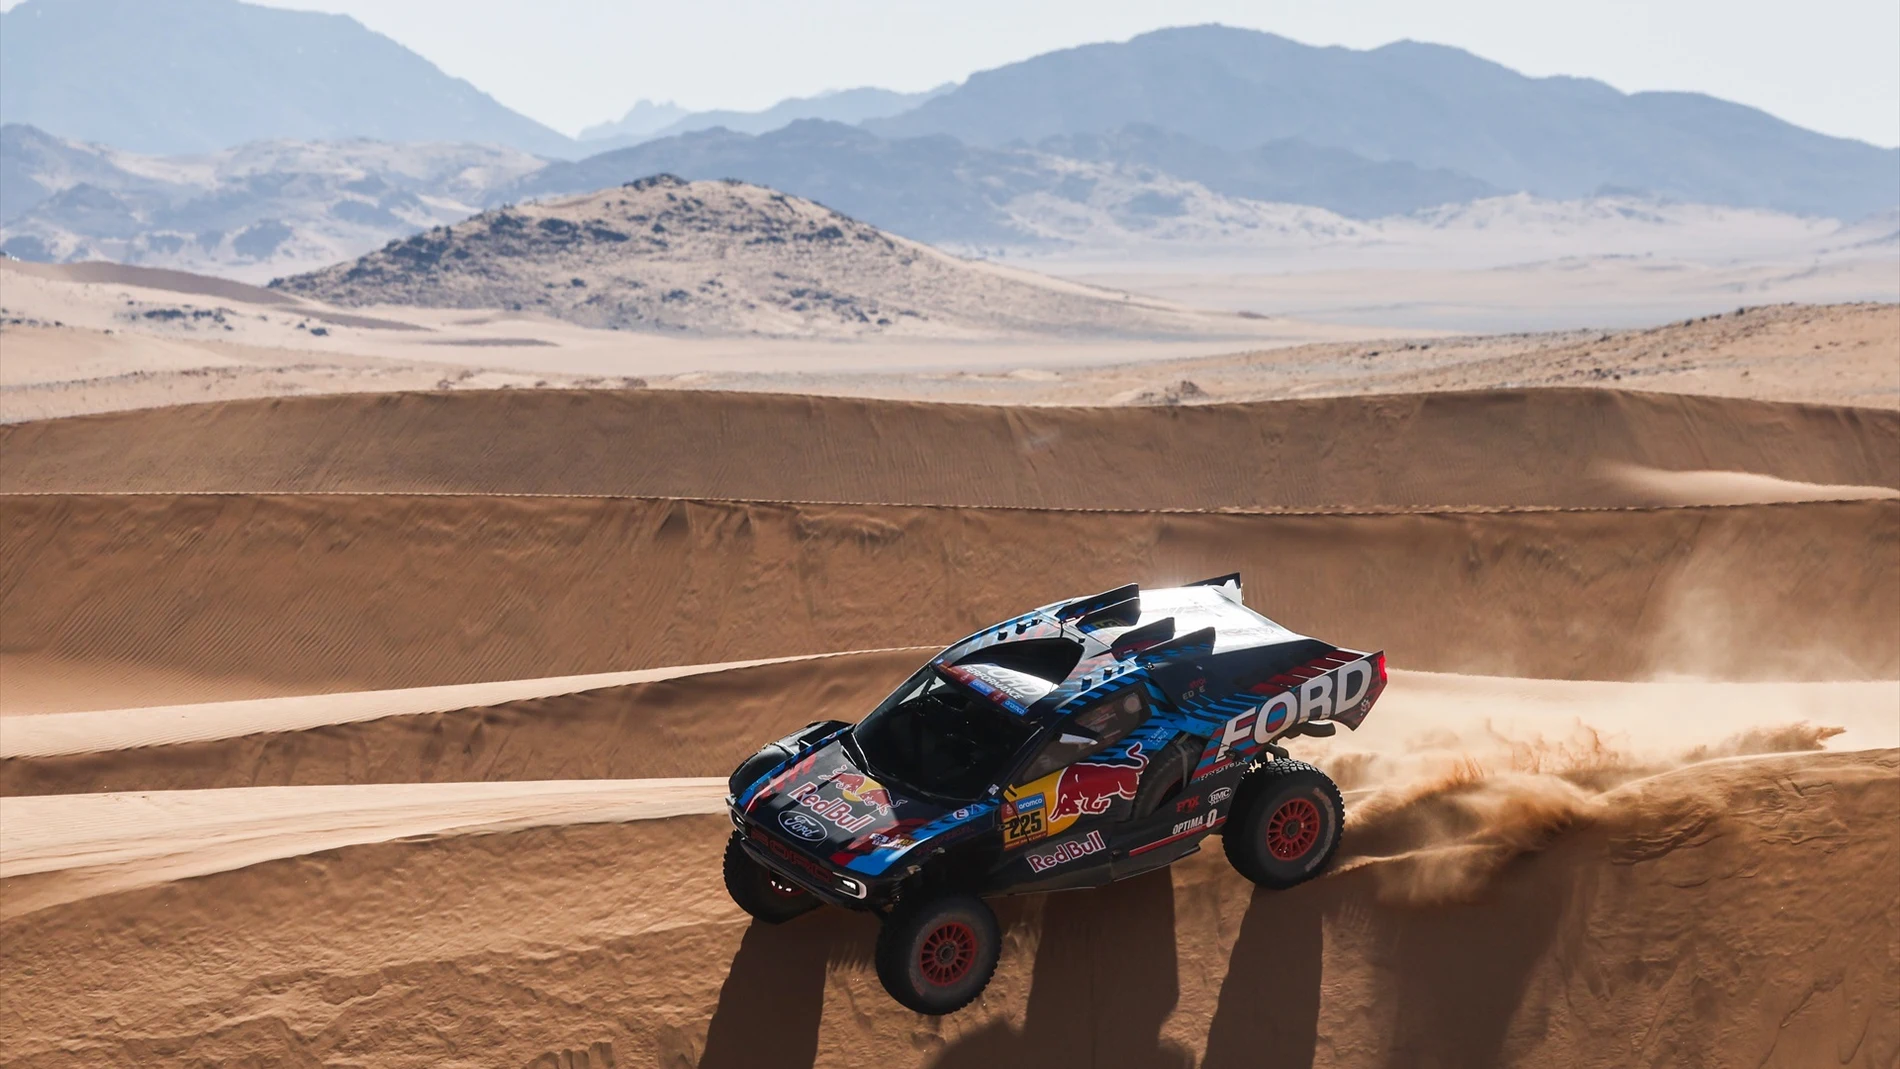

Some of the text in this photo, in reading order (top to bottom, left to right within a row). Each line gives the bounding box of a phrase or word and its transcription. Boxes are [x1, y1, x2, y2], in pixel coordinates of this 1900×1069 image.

[960, 665, 1024, 700] PERFORMANCE
[1004, 700, 1025, 715] aramco
[1215, 660, 1373, 763] FORD
[1018, 797, 1043, 810] aramco
[1176, 795, 1200, 813] FOX
[1210, 789, 1230, 802] BMC
[783, 814, 820, 838] Ford
[1009, 811, 1042, 839] 225
[1172, 815, 1203, 835] OPTIMA
[751, 827, 833, 883] FORD
